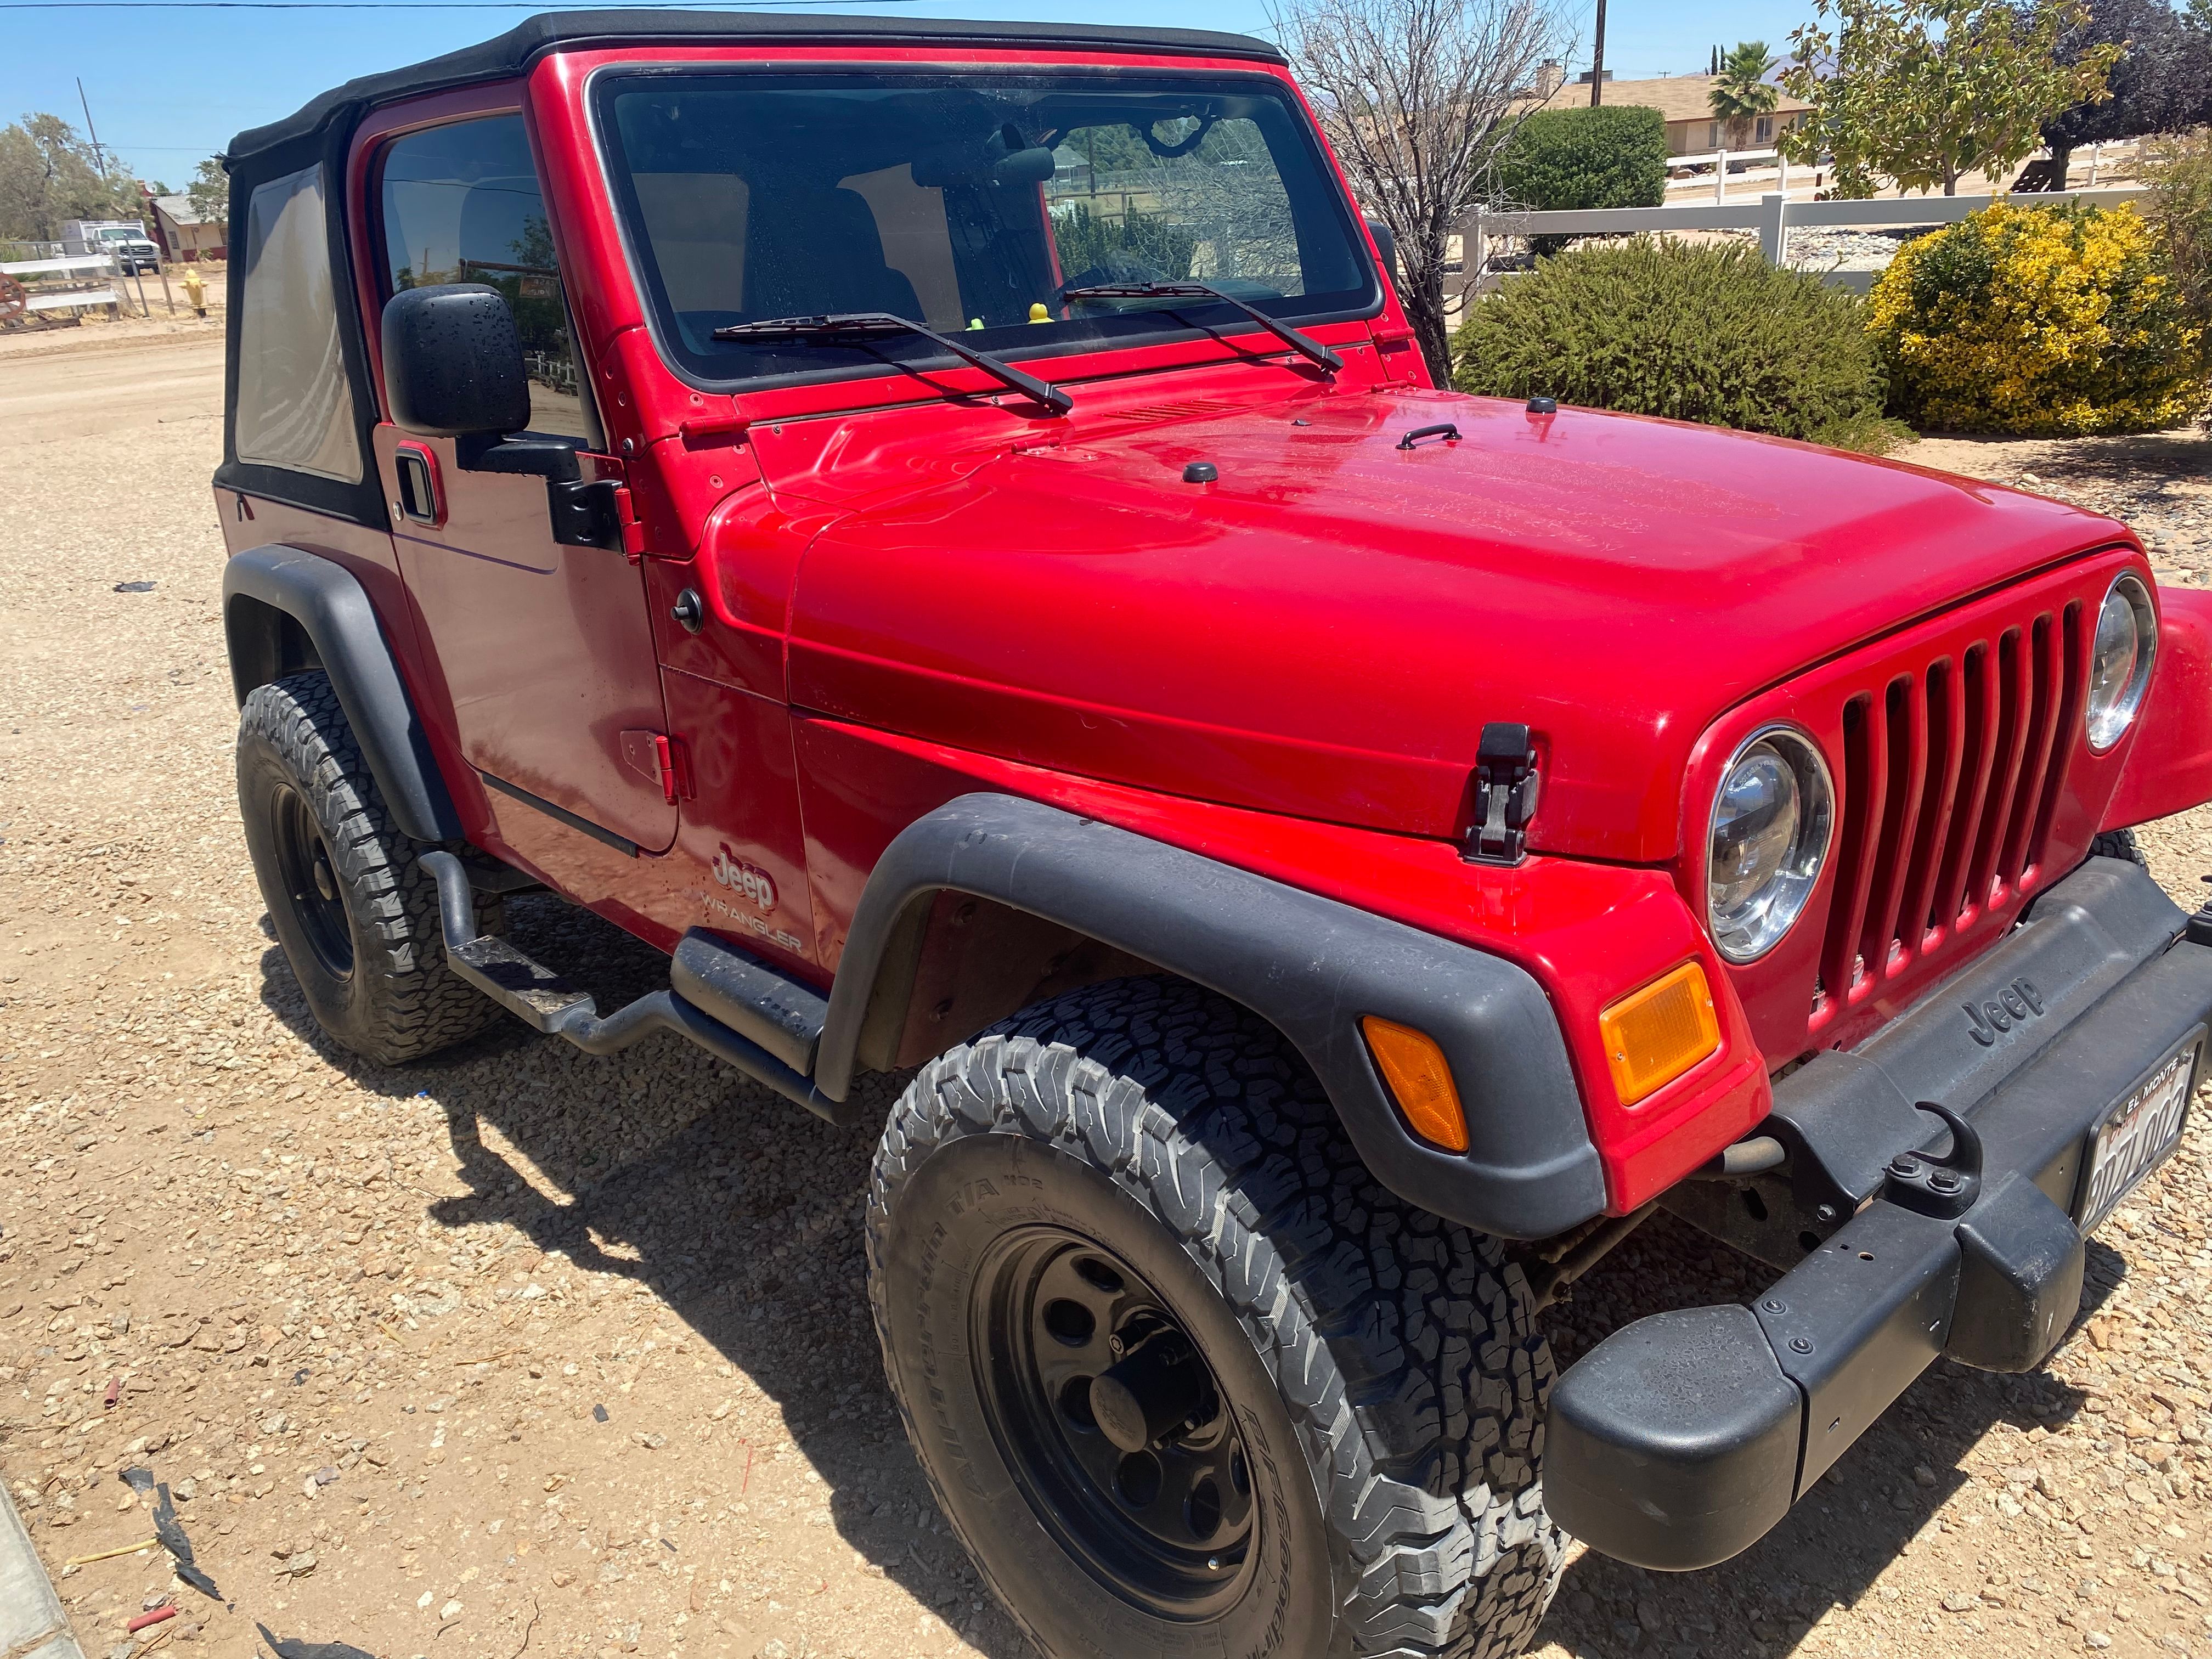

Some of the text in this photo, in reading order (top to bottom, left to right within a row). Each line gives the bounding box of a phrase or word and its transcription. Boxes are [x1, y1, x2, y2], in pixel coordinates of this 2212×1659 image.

[713, 848, 775, 912] Jeep
[700, 891, 802, 952] WRANGLER
[1961, 977, 2046, 1047] Jeep
[2126, 1095, 2140, 1115] EL
[2142, 1057, 2179, 1100] MONTE
[943, 1178, 1000, 1215] T/A
